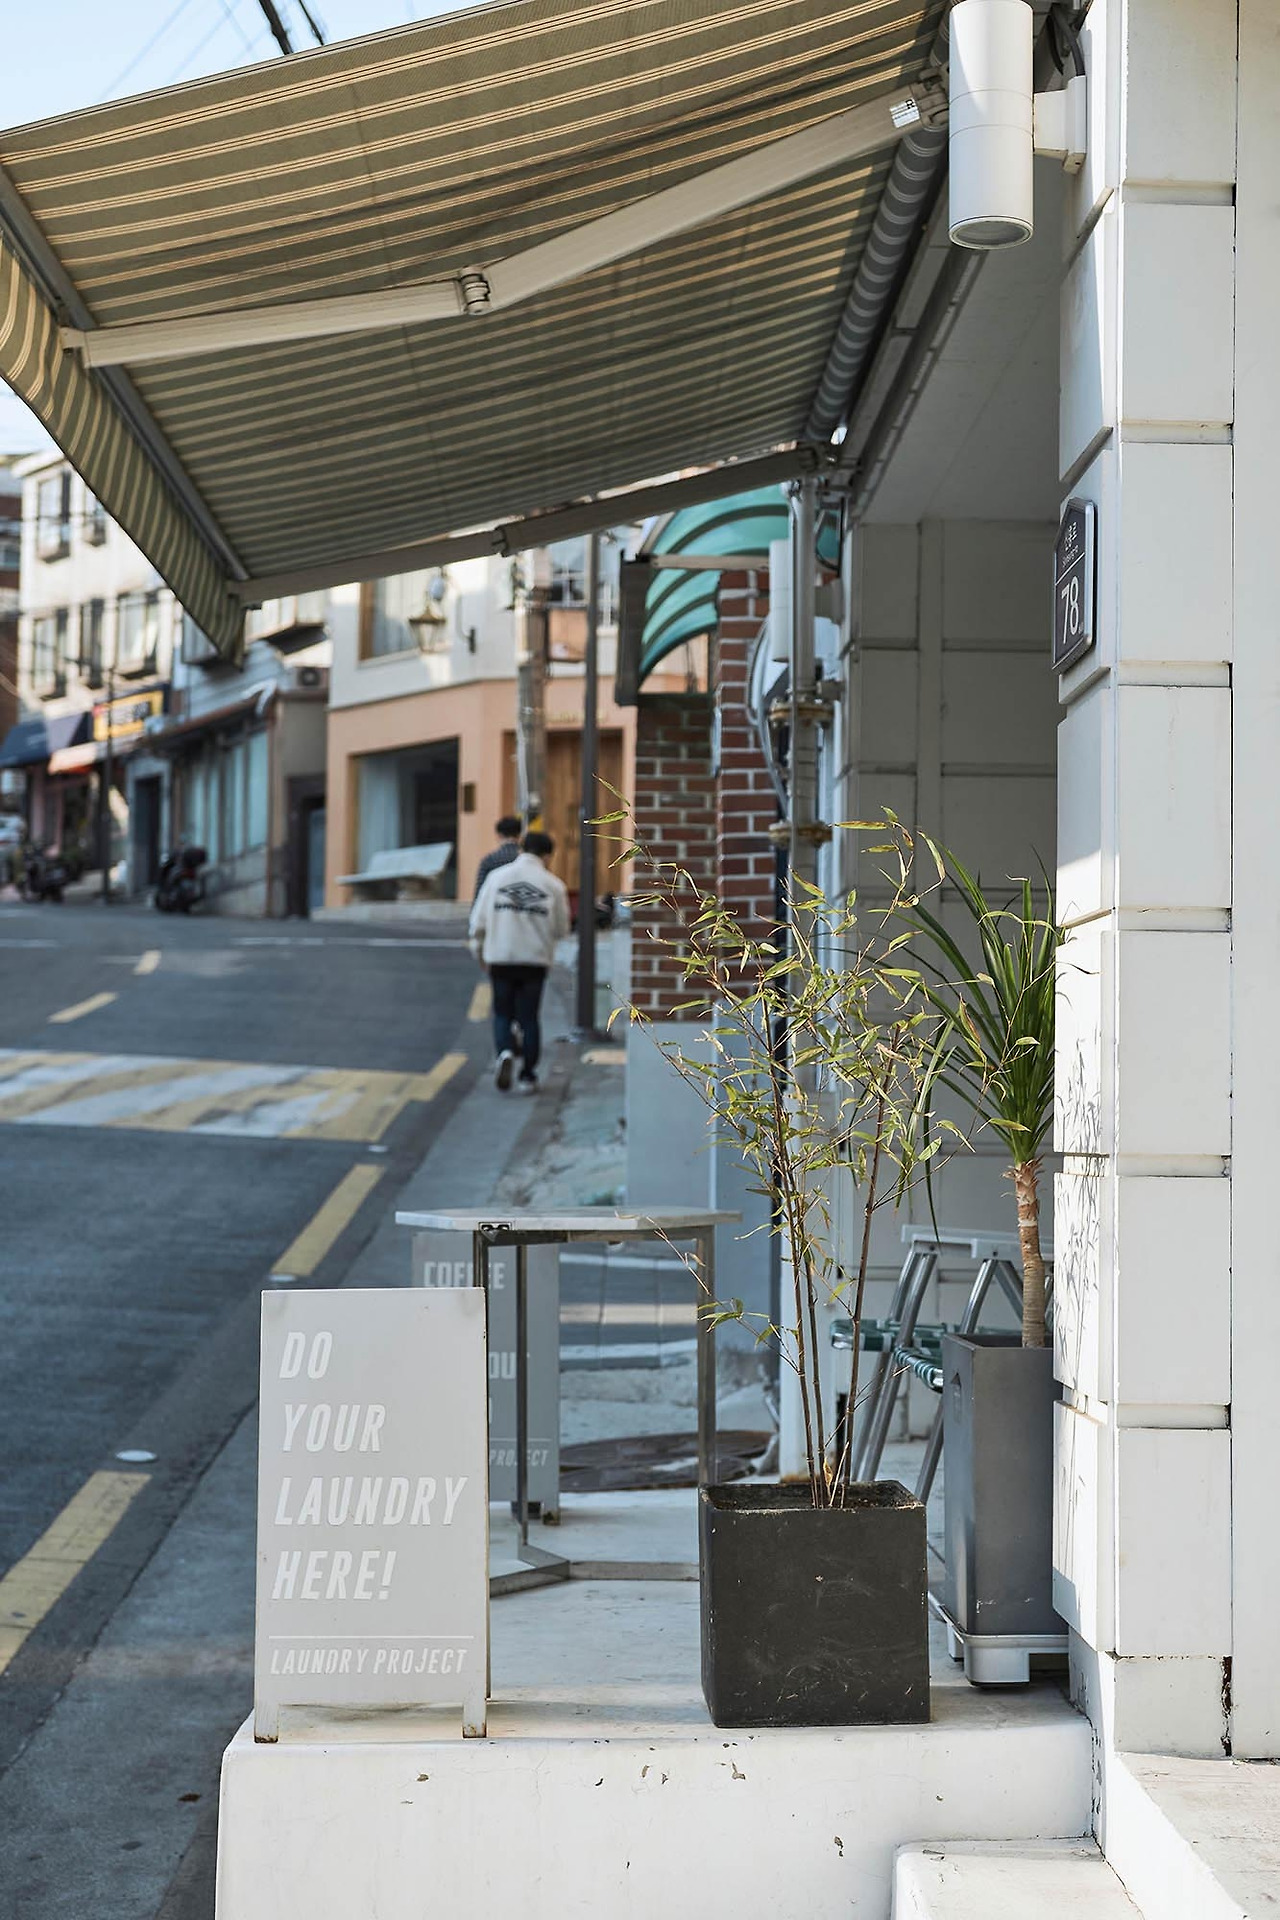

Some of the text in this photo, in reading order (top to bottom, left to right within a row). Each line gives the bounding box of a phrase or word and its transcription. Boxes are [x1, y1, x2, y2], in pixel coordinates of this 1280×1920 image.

[1061, 576, 1079, 645] 78
[424, 1261, 505, 1289] COFE
[279, 1331, 333, 1379] DO
[283, 1404, 386, 1452] YOUR
[489, 1448, 549, 1467] PROCT
[274, 1476, 469, 1526] LAUNDRY
[271, 1551, 397, 1600] HERE!
[270, 1648, 468, 1675] LAUNDRY PROJECT
